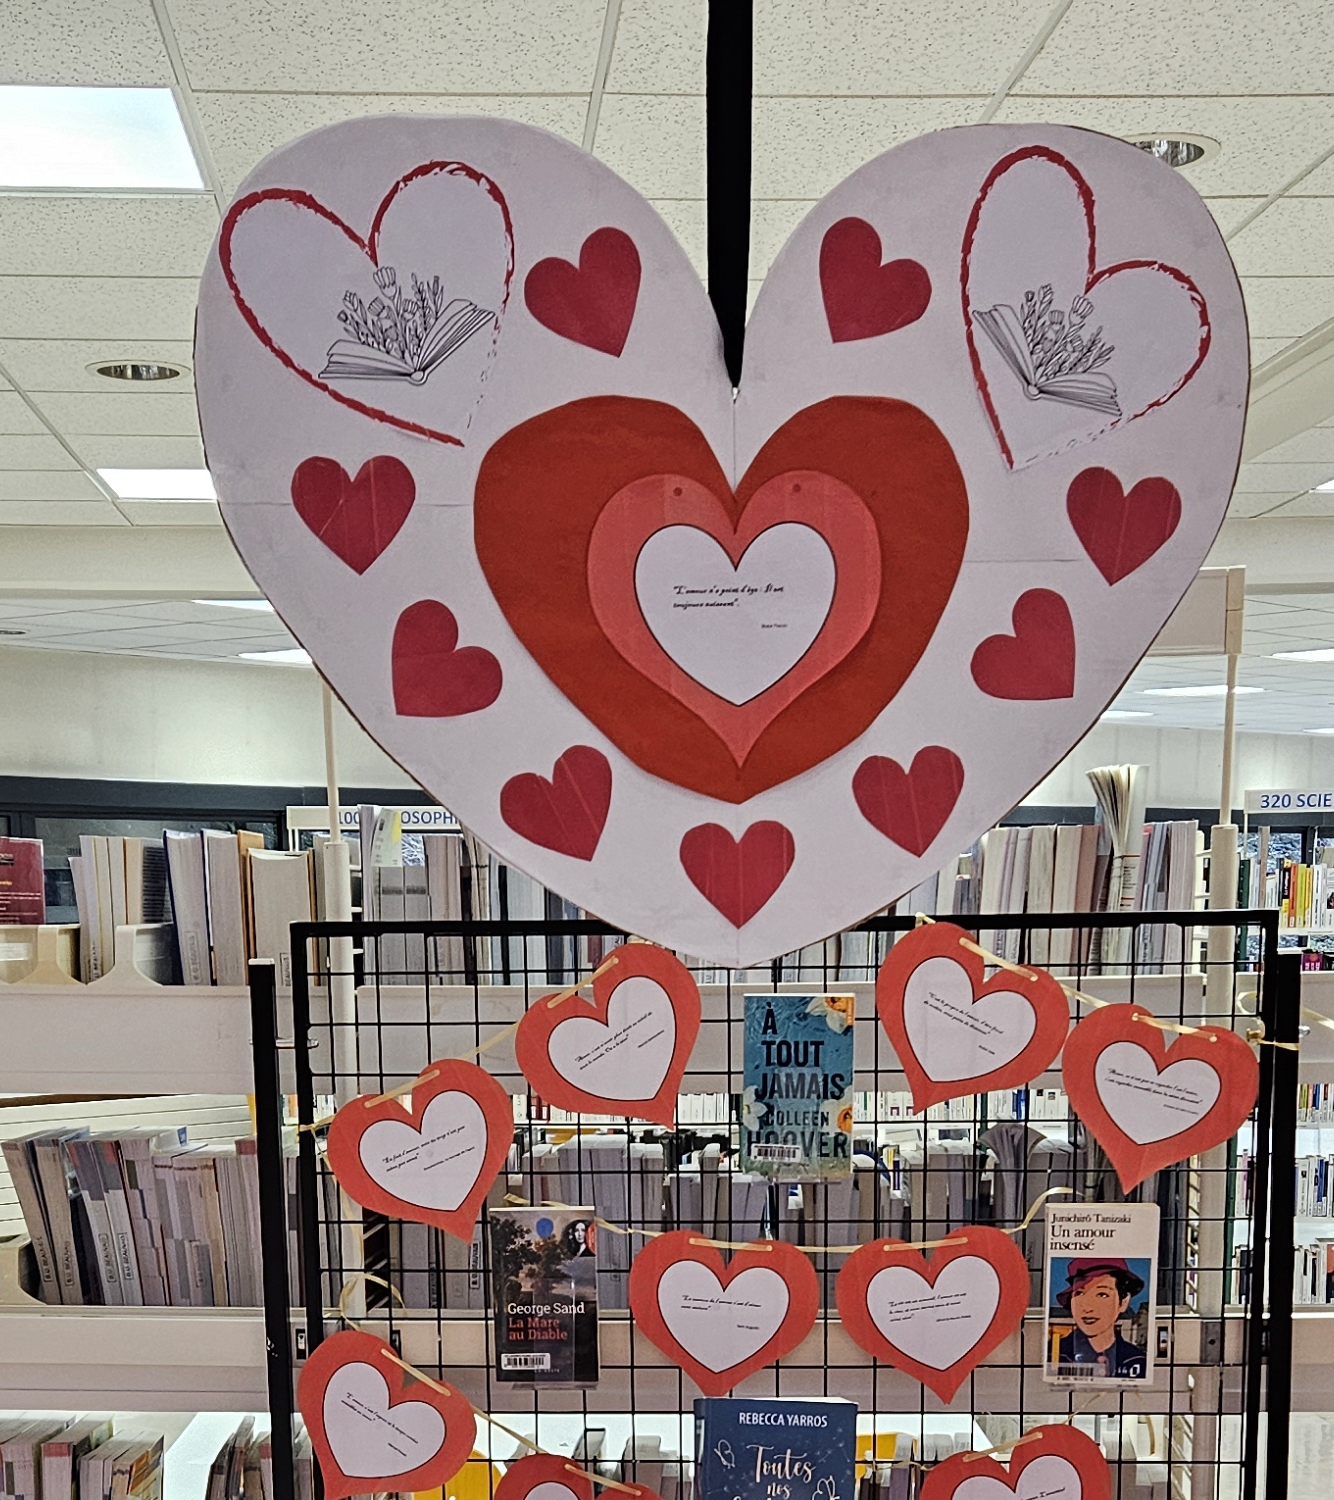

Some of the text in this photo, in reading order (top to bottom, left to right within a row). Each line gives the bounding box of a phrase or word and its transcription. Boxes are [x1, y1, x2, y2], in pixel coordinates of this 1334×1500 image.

[1260, 794, 1291, 809] 320
[761, 1001, 778, 1035] À
[761, 1040, 825, 1068] TOUT
[755, 1073, 845, 1101] JAMAIS
[766, 1111, 829, 1127] COLLEEN
[1093, 1213, 1131, 1224] Tanizaki
[1050, 1224, 1116, 1238] Un amour
[1050, 1238, 1095, 1251] insensé
[508, 1302, 585, 1317] George Sand
[508, 1317, 560, 1328] La Mare
[509, 1328, 568, 1341] au Diable
[739, 1412, 828, 1428] REBECCA YARROS
[746, 1444, 816, 1484] Toutes
[767, 1482, 792, 1499] nos
